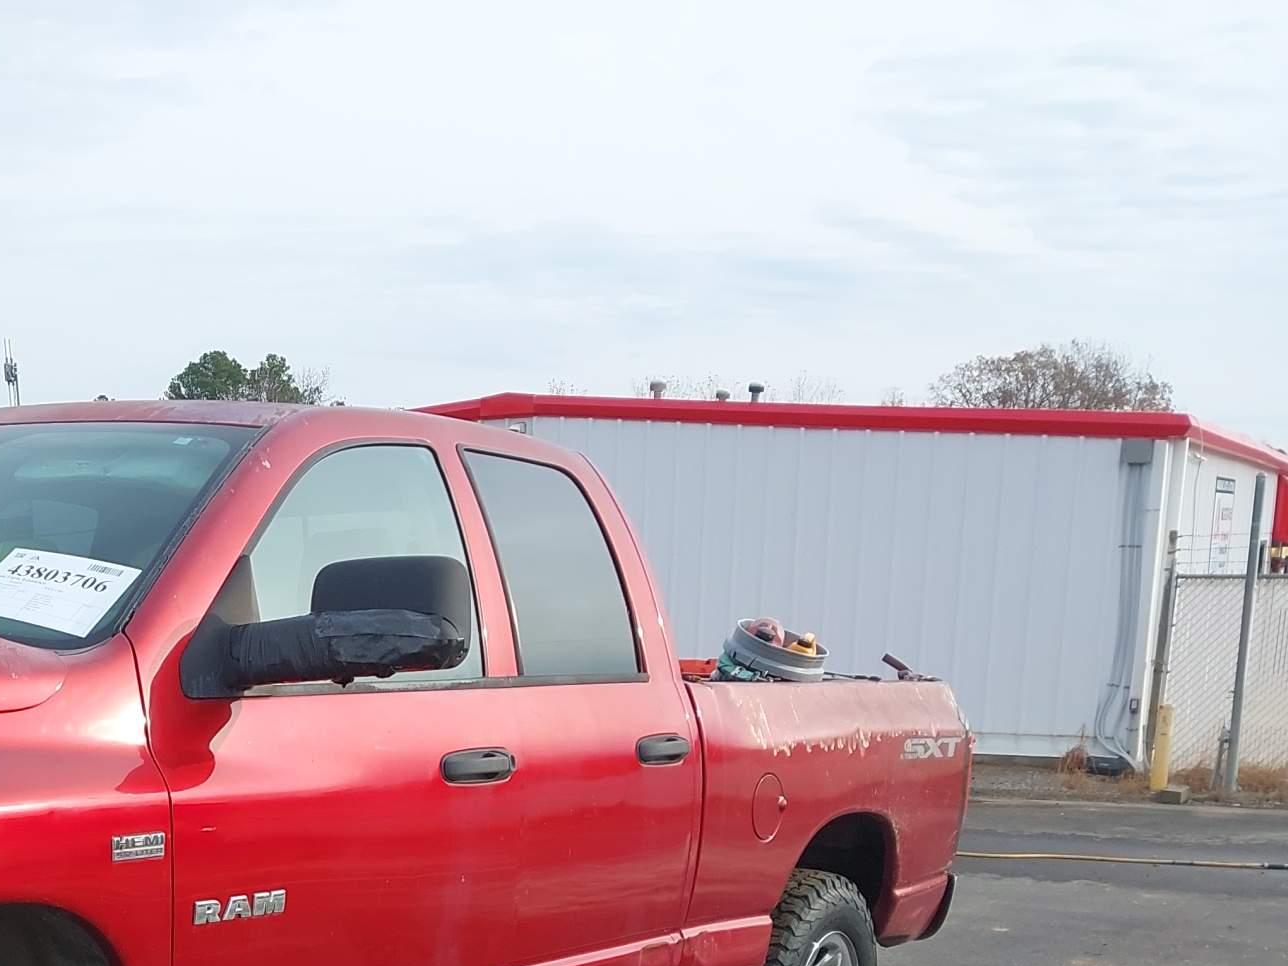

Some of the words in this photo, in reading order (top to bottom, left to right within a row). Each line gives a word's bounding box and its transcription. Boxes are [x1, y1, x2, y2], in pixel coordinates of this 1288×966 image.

[8, 563, 111, 593] 43803706
[900, 737, 961, 759] SXT
[114, 834, 164, 850] HEMI
[194, 889, 287, 925] RAM
